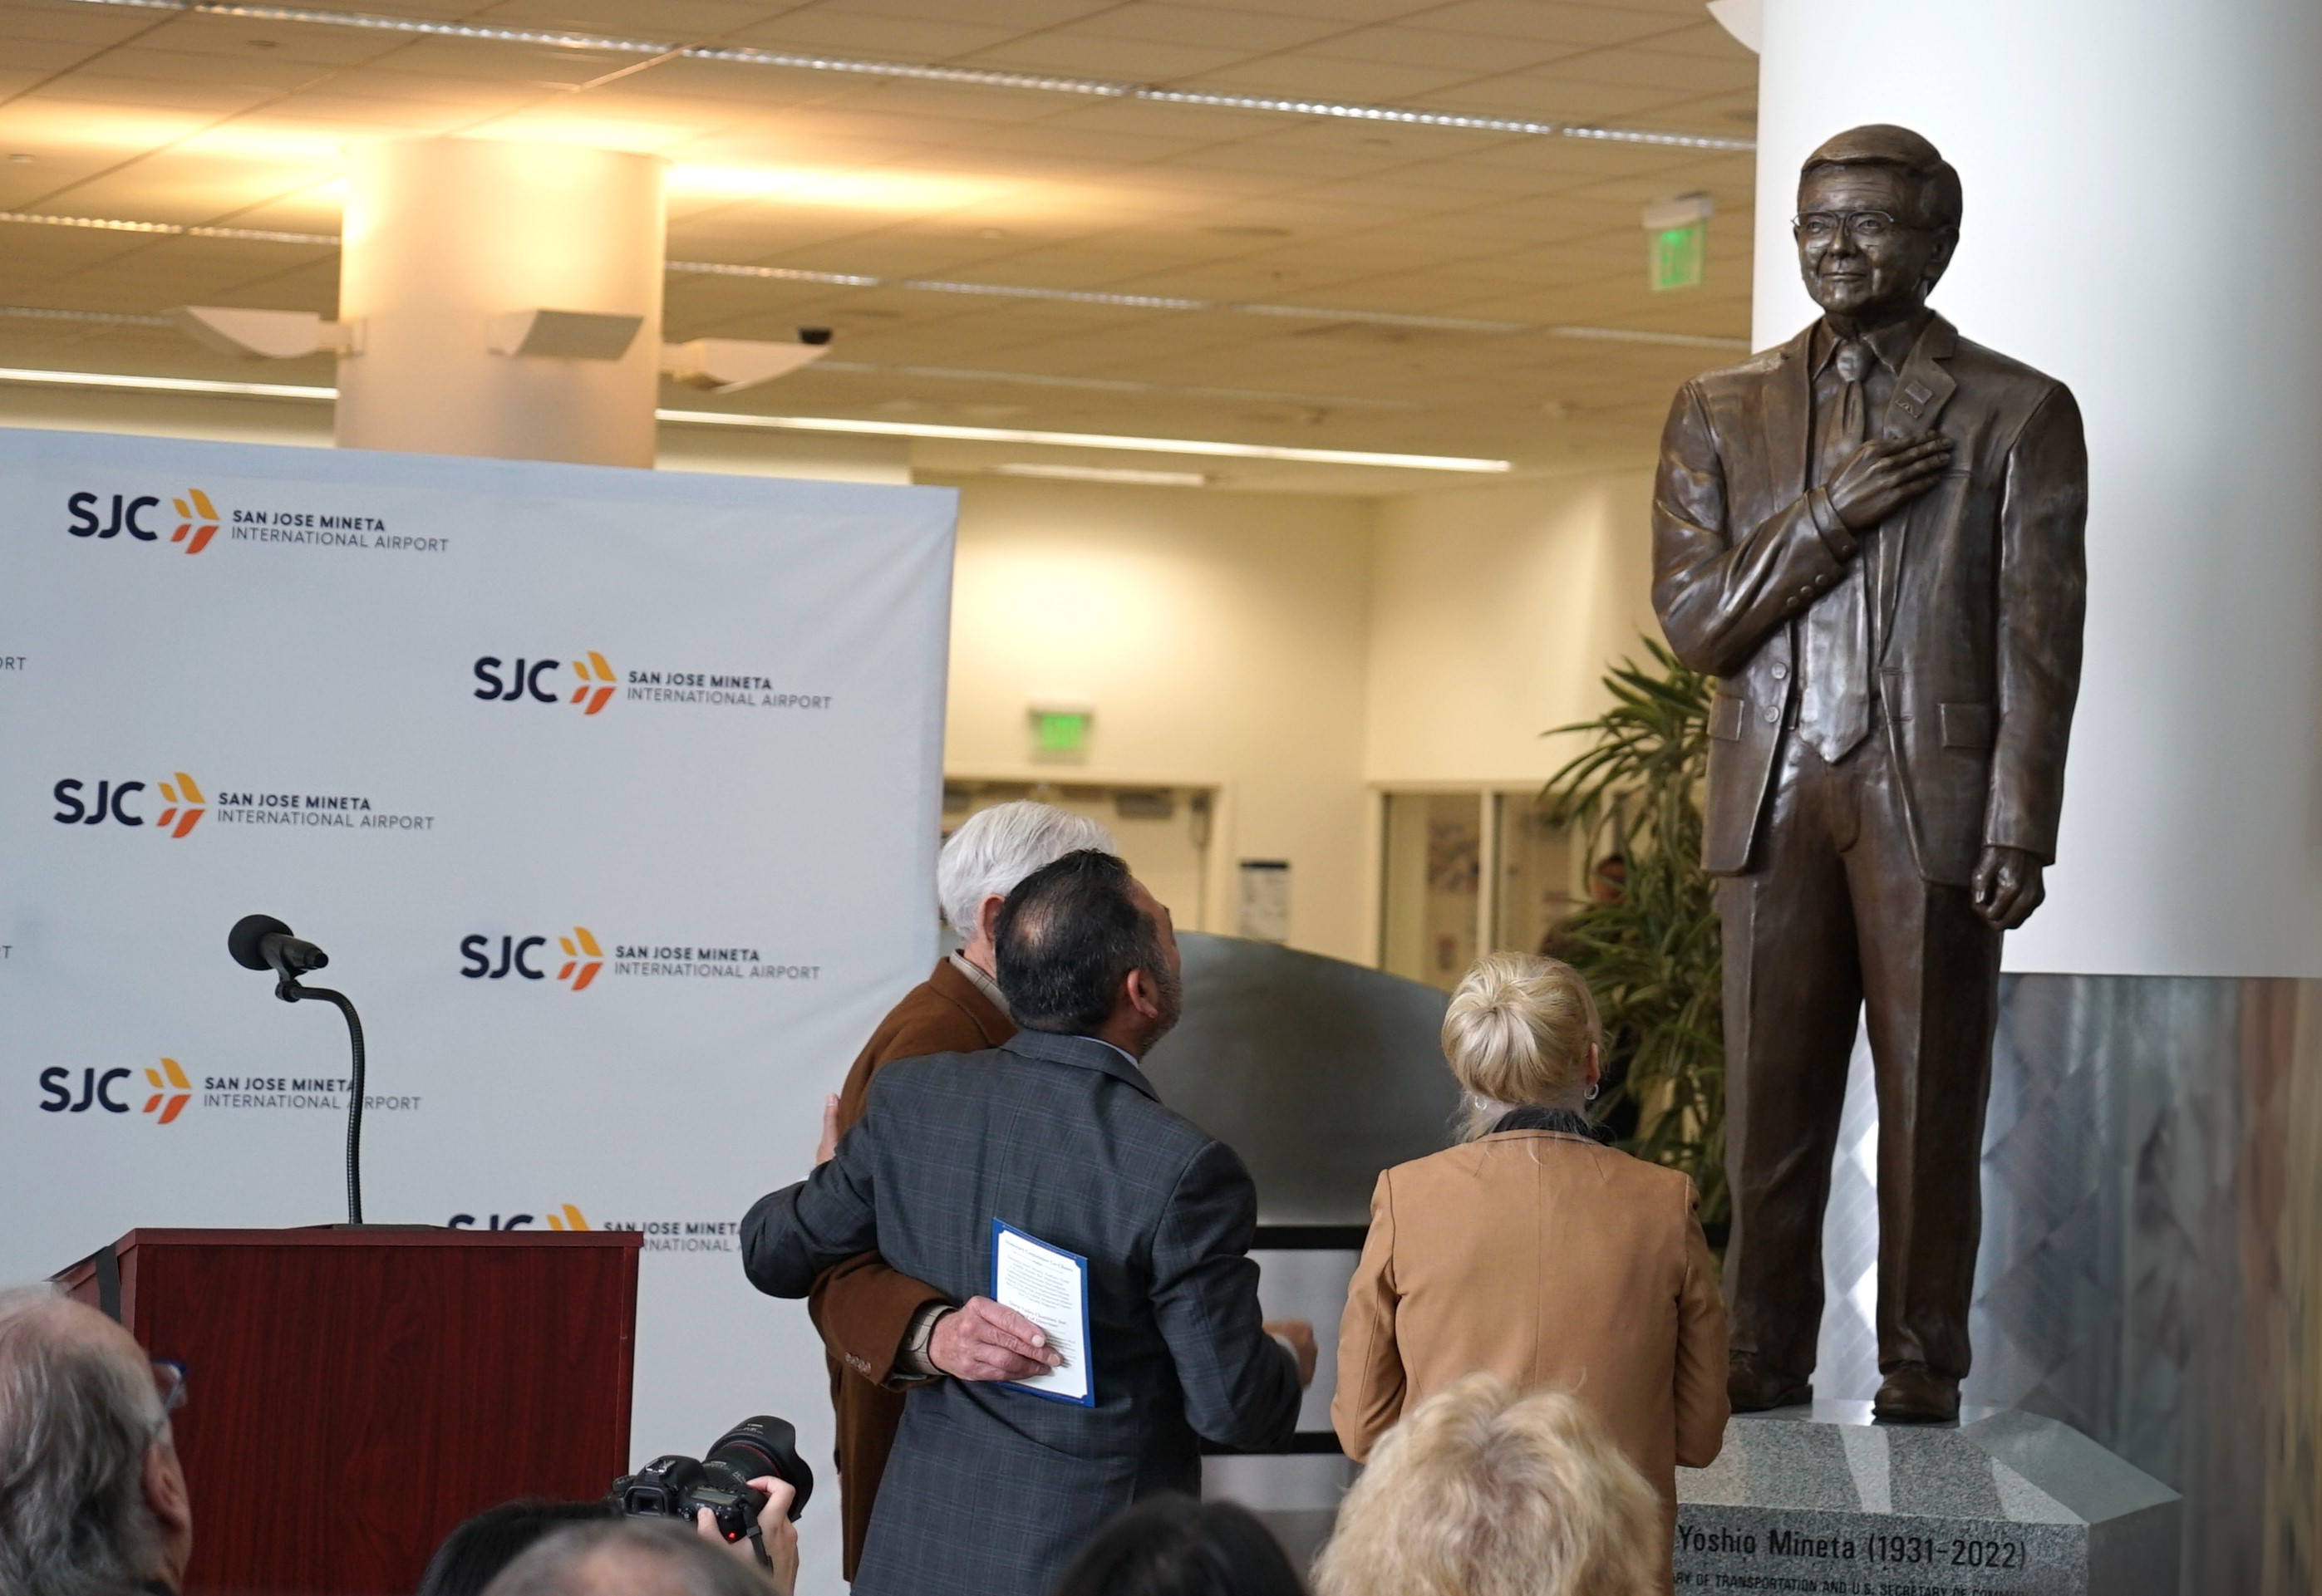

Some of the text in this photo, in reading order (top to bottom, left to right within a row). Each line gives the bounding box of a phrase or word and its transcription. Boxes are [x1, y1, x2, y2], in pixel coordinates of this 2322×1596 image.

[68, 491, 160, 541] SJC
[232, 509, 386, 532] SAN JOSE MINETA
[231, 526, 450, 552] INTERNATIONAL AIRPORT
[473, 656, 560, 703] SJC
[627, 670, 773, 690] SAN JOSE MINETA
[627, 687, 832, 710] INTERNATIONAL AIRPORT
[53, 778, 145, 827] SJC
[218, 792, 371, 811] SAN JOSE MINETA
[217, 808, 435, 831] INTERNATIONAL AIRPORT
[460, 934, 546, 980] SJC
[615, 945, 760, 962] SAN JOSE MINETA
[614, 961, 821, 980] INTERNATIONAL AIRPORT
[39, 1066, 132, 1113] SJC
[204, 1077, 239, 1090] SAN
[244, 1077, 287, 1091] JOSE
[204, 1093, 341, 1110] INTERNATIONAL
[685, 1222, 740, 1235] MINET
[1678, 1525, 2025, 1571] Yoshio Mineta (1931-2022)
[1715, 1574, 1817, 1592] TRANSPORTATION
[1822, 1581, 1847, 1594] AND
